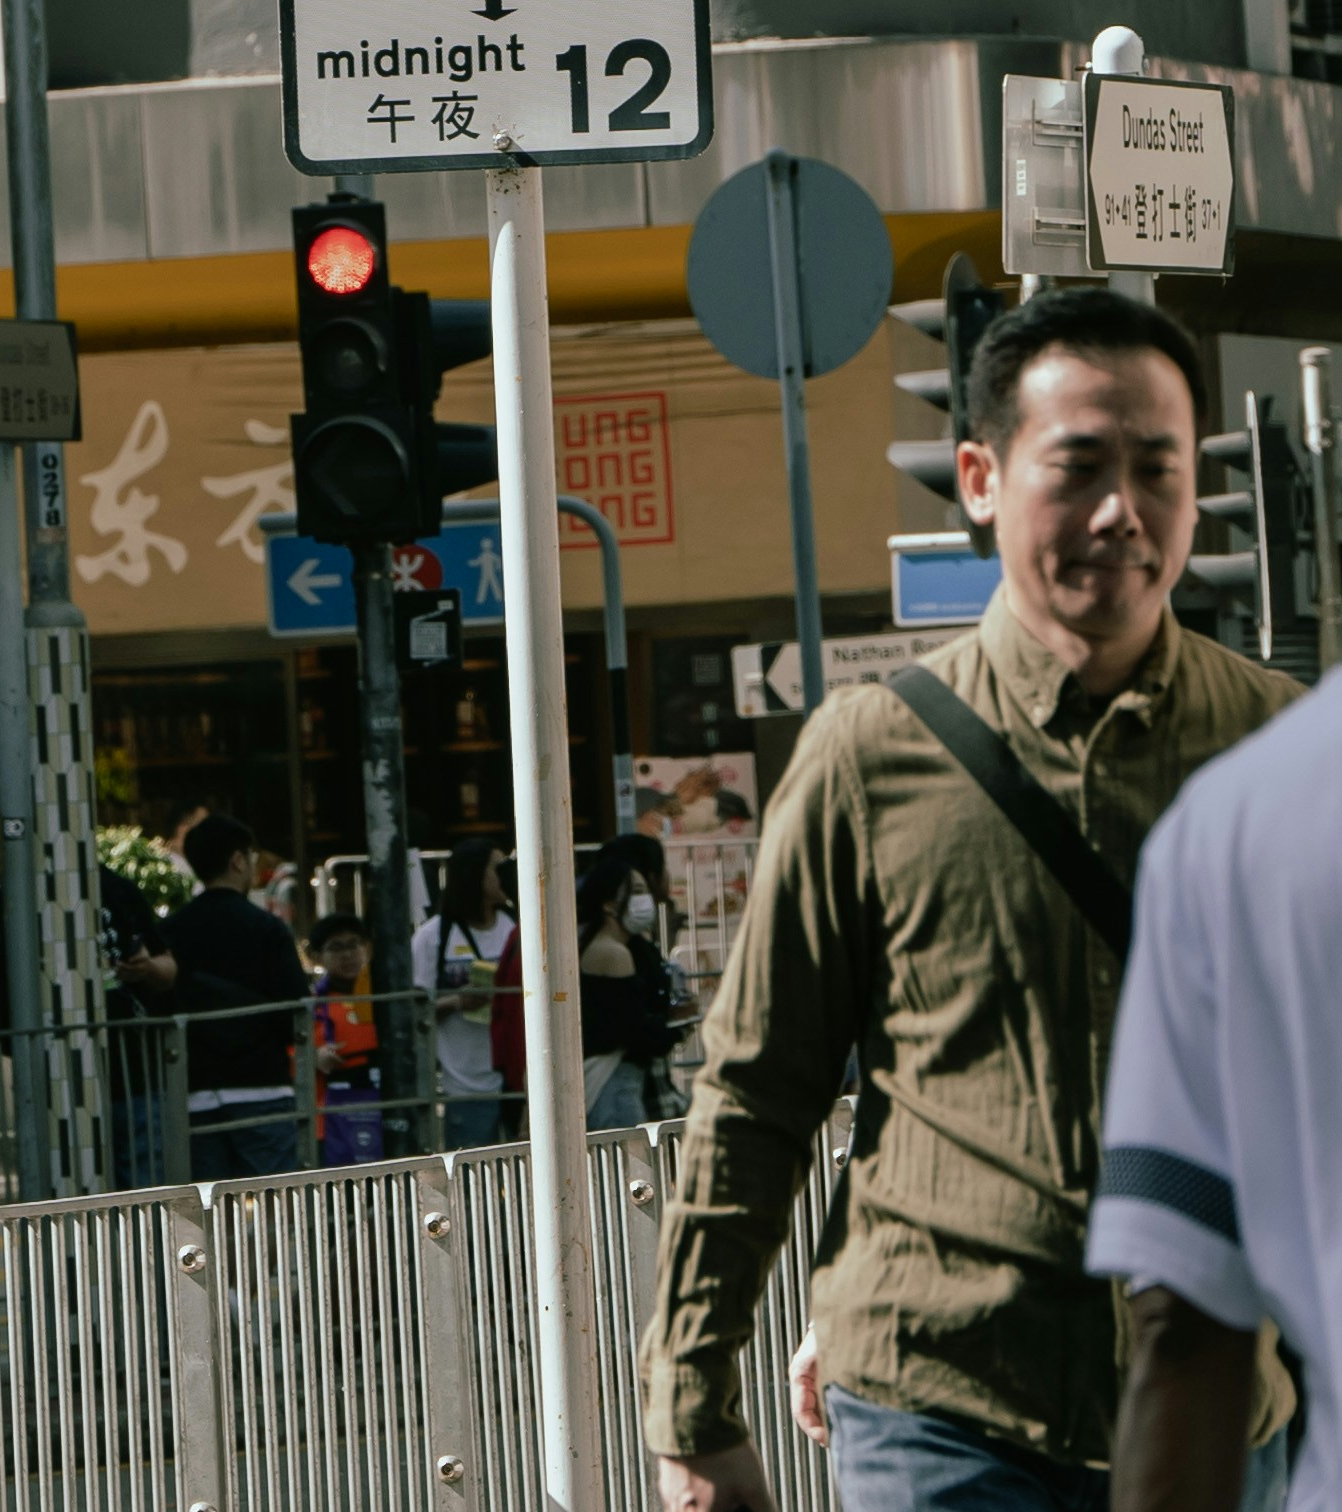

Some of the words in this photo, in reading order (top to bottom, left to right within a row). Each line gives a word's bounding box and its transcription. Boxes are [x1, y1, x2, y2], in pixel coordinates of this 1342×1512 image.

[317, 34, 526, 83] midnight
[556, 38, 672, 134] 12
[366, 91, 481, 145] 午夜
[1122, 104, 1166, 152] Dundas
[1169, 107, 1205, 154] Street
[1134, 182, 1197, 243] 登打士街
[42, 453, 60, 526] 0278
[832, 643, 905, 664] Nathan
